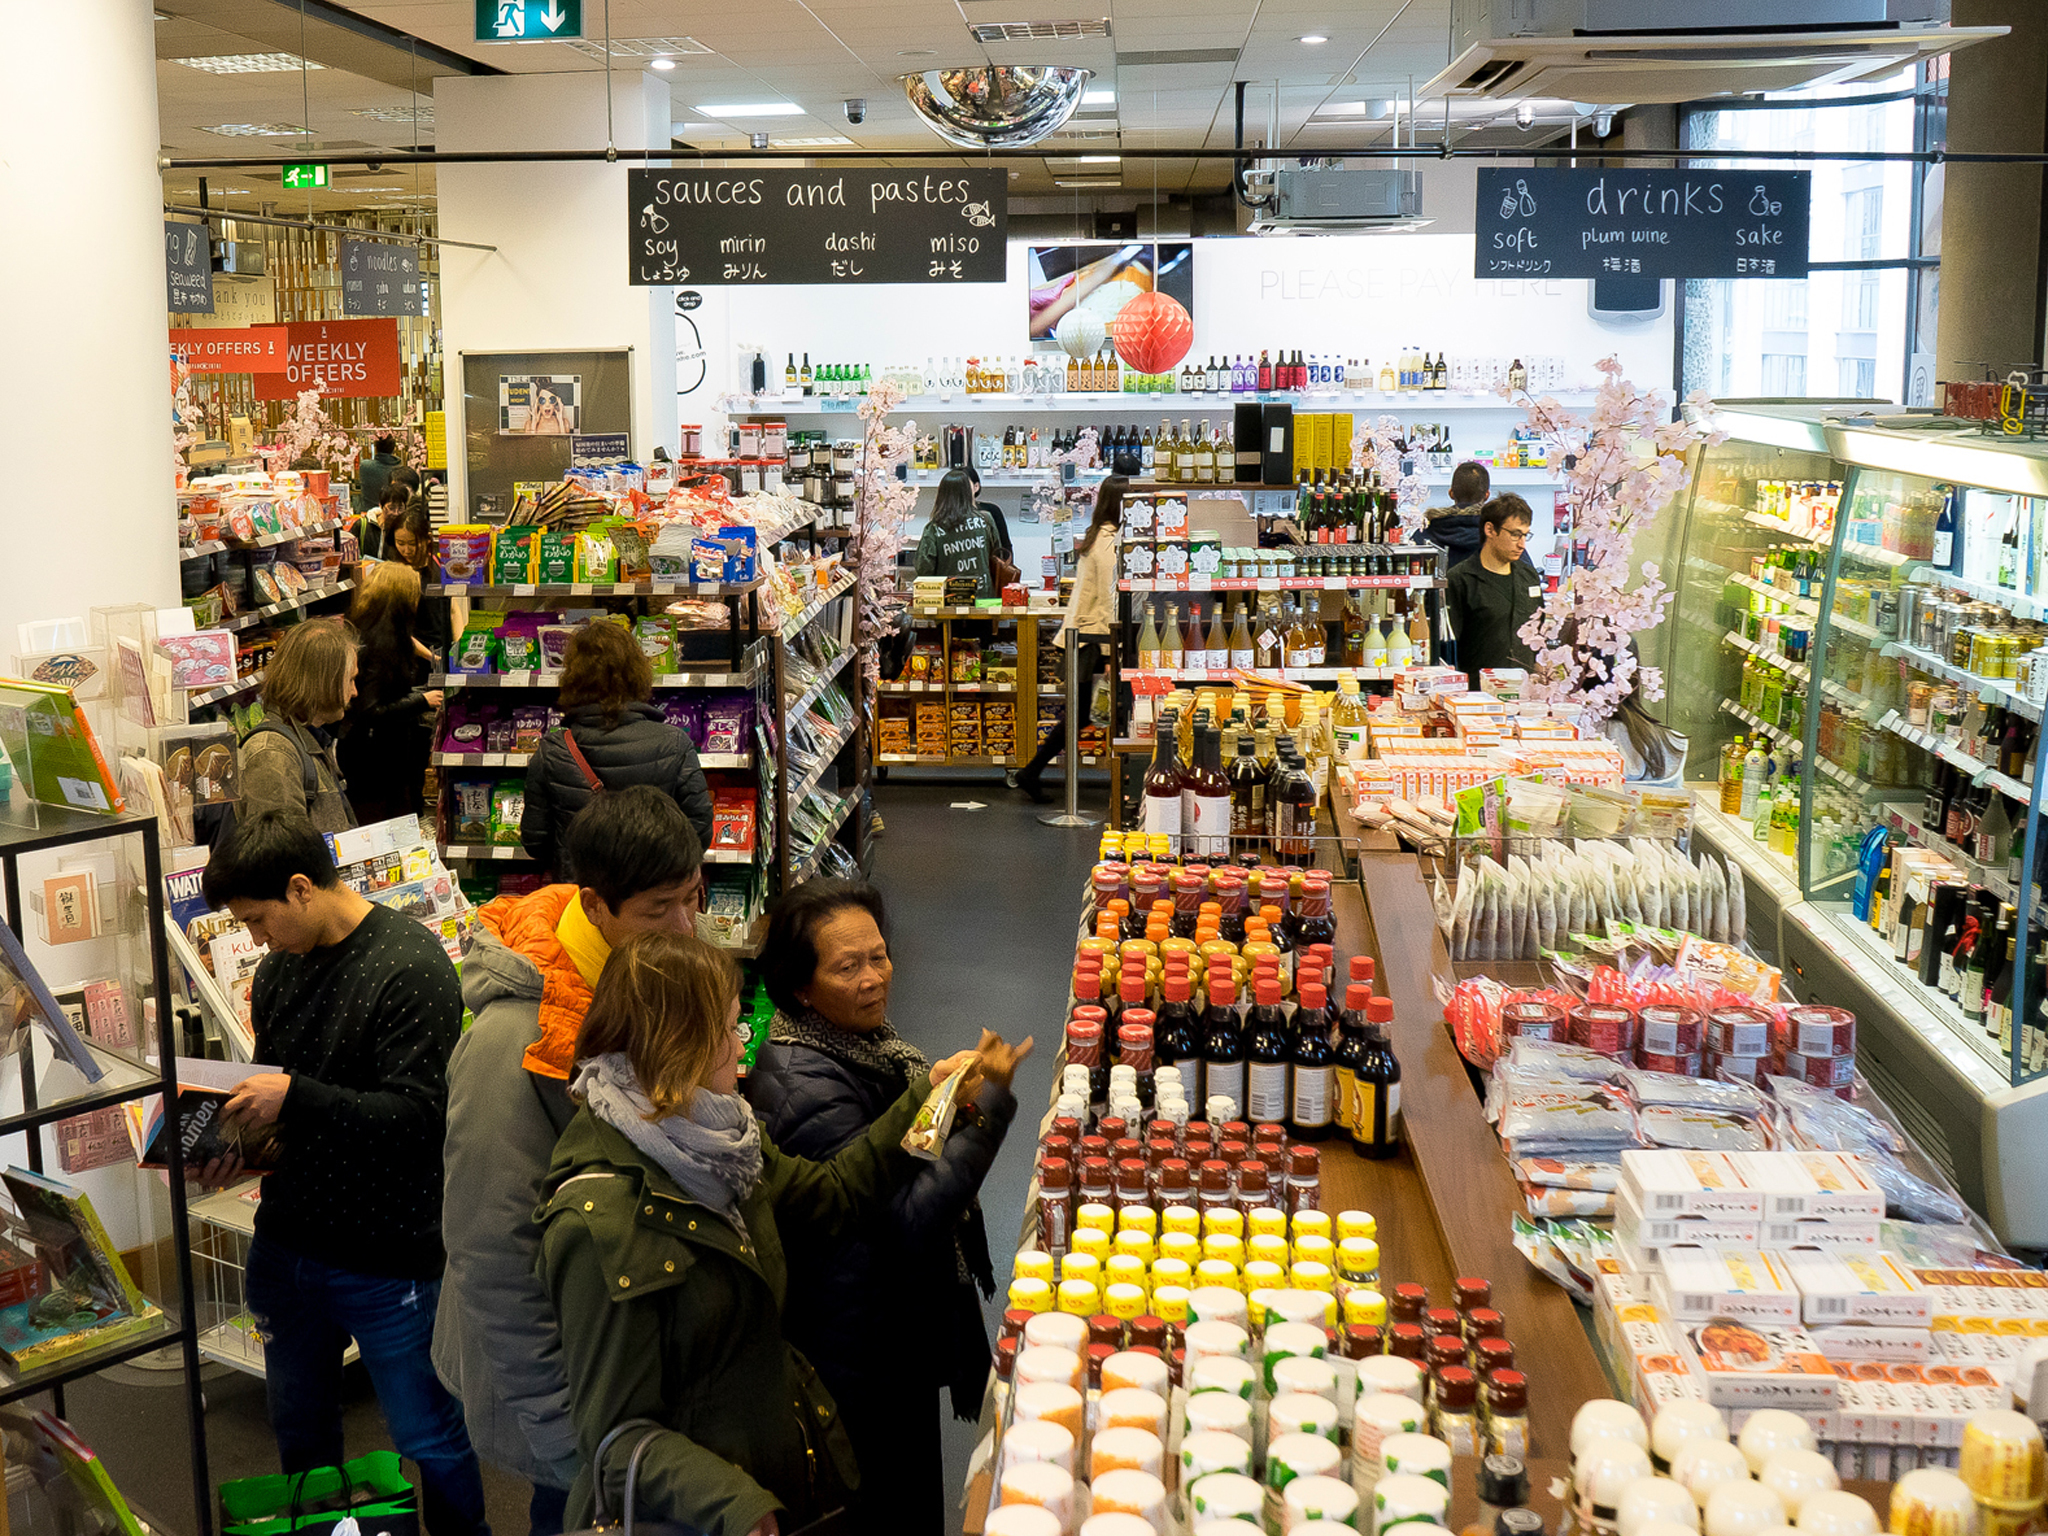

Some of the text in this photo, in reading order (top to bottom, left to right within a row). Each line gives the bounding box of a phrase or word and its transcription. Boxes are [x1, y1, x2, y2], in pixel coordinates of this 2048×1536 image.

[656, 175, 970, 213] sauces and pastes
[1587, 178, 1724, 216] drinks
[720, 234, 766, 254] mirin
[825, 231, 877, 252] dashi
[930, 234, 980, 254] miso
[1493, 225, 1783, 253] soft plum wine sake
[645, 238, 679, 266] soy
[641, 264, 690, 282] しょうゆ
[723, 262, 767, 280] みりん
[830, 260, 864, 277] だし
[929, 259, 964, 279] みそ
[1490, 258, 1551, 274] ソフトドリンク
[170, 269, 207, 291] seaweed
[1260, 268, 1385, 300] PLEASE
[1401, 268, 1460, 299] PAY
[244, 292, 266, 308] you
[170, 341, 261, 356] EKLY OFFERS
[287, 342, 367, 362] WEEKLY
[287, 362, 367, 383] OFFERS
[943, 536, 986, 556] ANYONE
[957, 557, 977, 573] OUT
[168, 872, 204, 899] WAT
